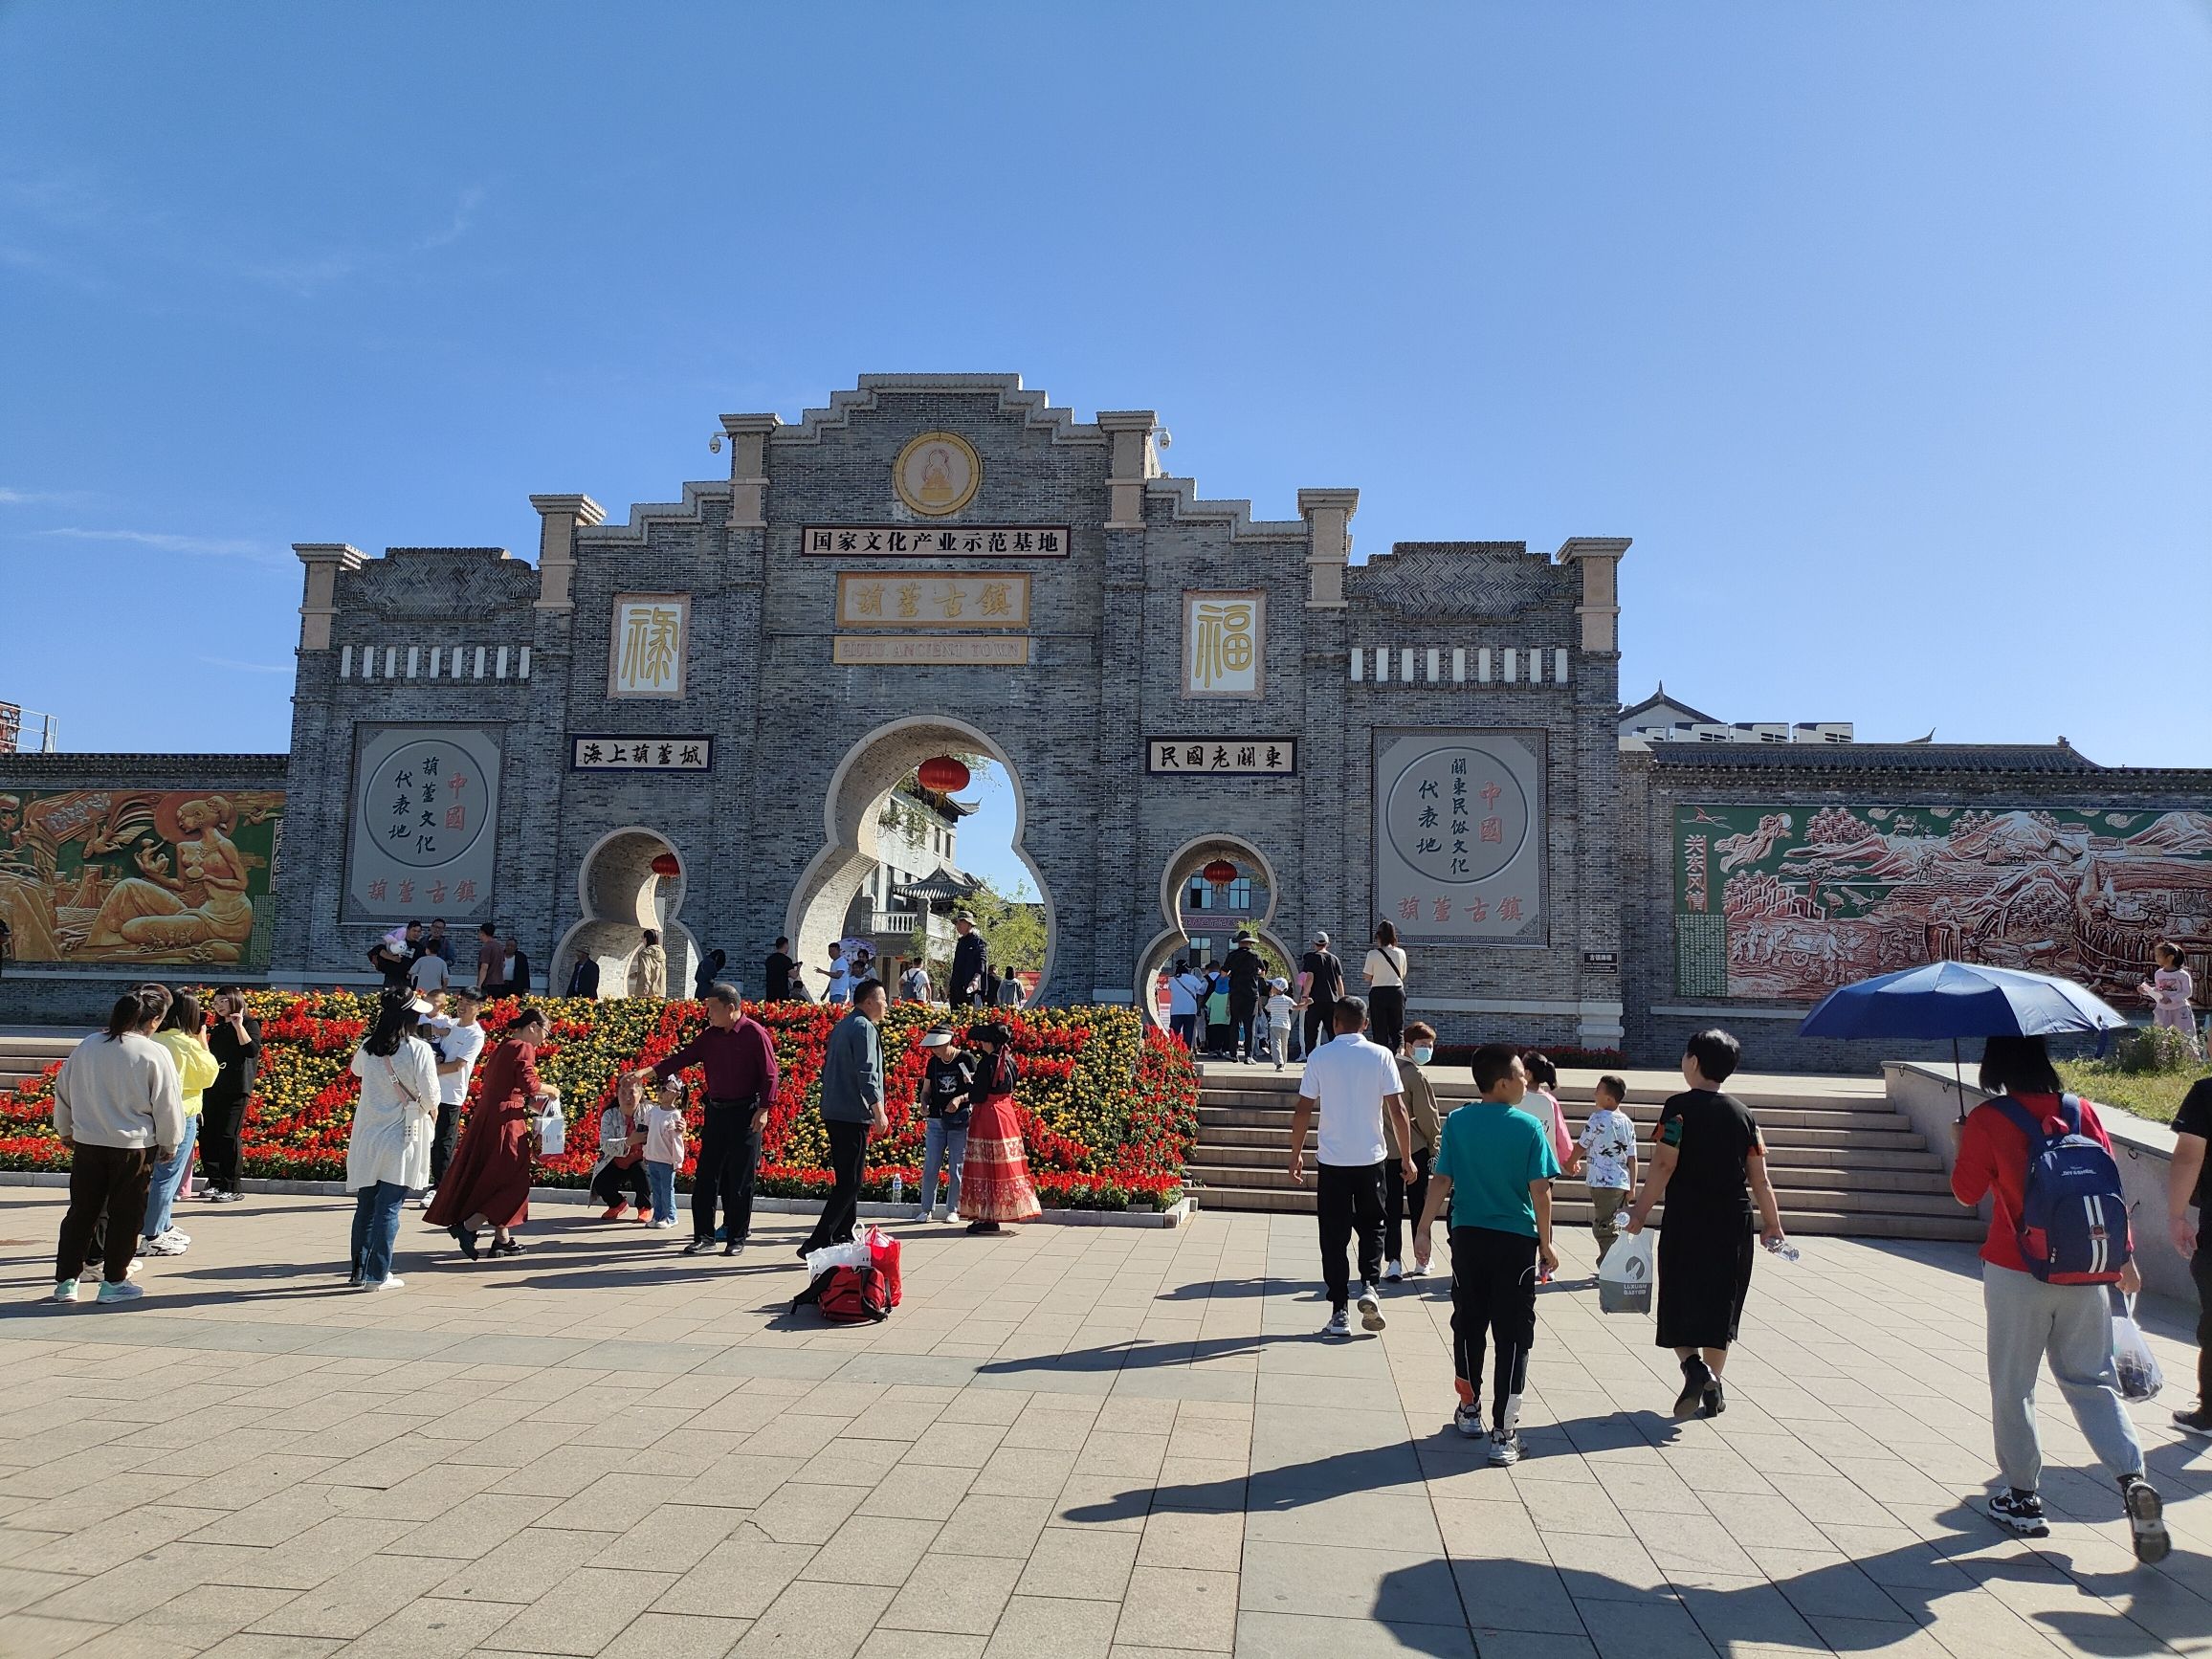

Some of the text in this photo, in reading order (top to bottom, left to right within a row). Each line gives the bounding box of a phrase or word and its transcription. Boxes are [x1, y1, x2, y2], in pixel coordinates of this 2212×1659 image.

[812, 531, 1059, 553] 国家文化产业示范基地
[893, 642, 963, 657] ANCIENT
[971, 642, 1020, 657] TOWN
[1195, 603, 1252, 688] 福
[388, 769, 412, 840] 代表地
[1416, 779, 1442, 854] 代表地
[1684, 834, 1708, 912] 关东风情
